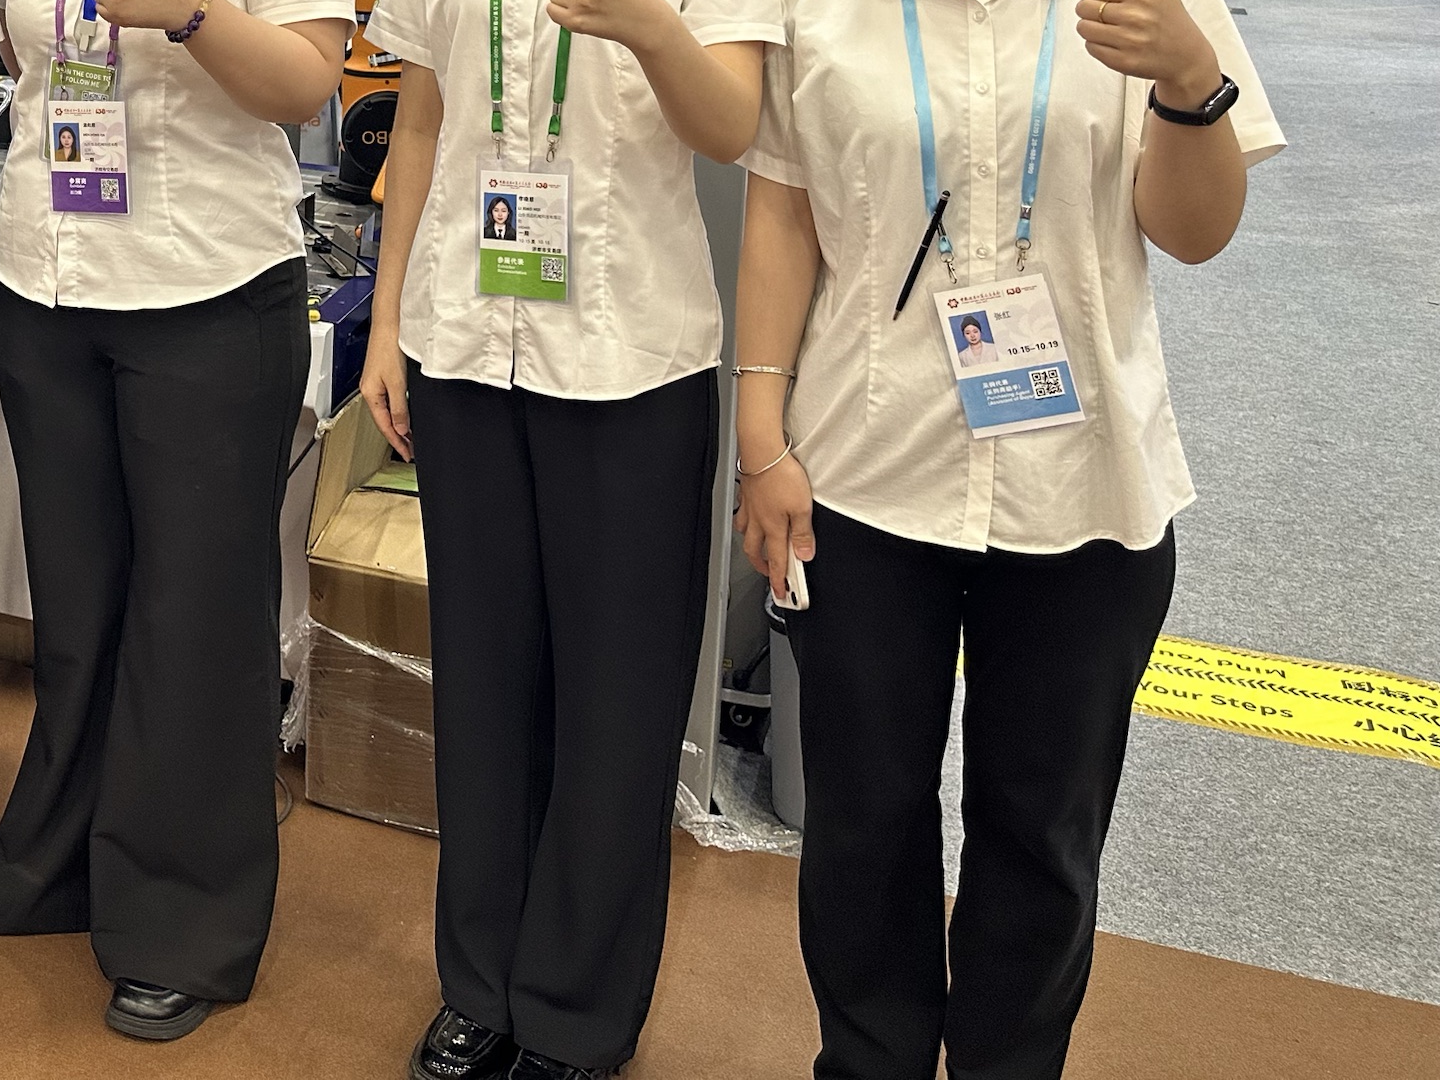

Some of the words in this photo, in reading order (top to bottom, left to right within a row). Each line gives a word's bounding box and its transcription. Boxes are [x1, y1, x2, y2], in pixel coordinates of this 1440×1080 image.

[56, 67, 72, 76] SAN
[73, 70, 85, 78] THE
[85, 72, 102, 81] CODE
[65, 76, 90, 86] FOLLOW
[91, 80, 100, 88] ME
[1152, 648, 1210, 665] You
[1217, 658, 1286, 679] Mind
[1140, 681, 1203, 702] Your
[1210, 694, 1294, 719] Steps
